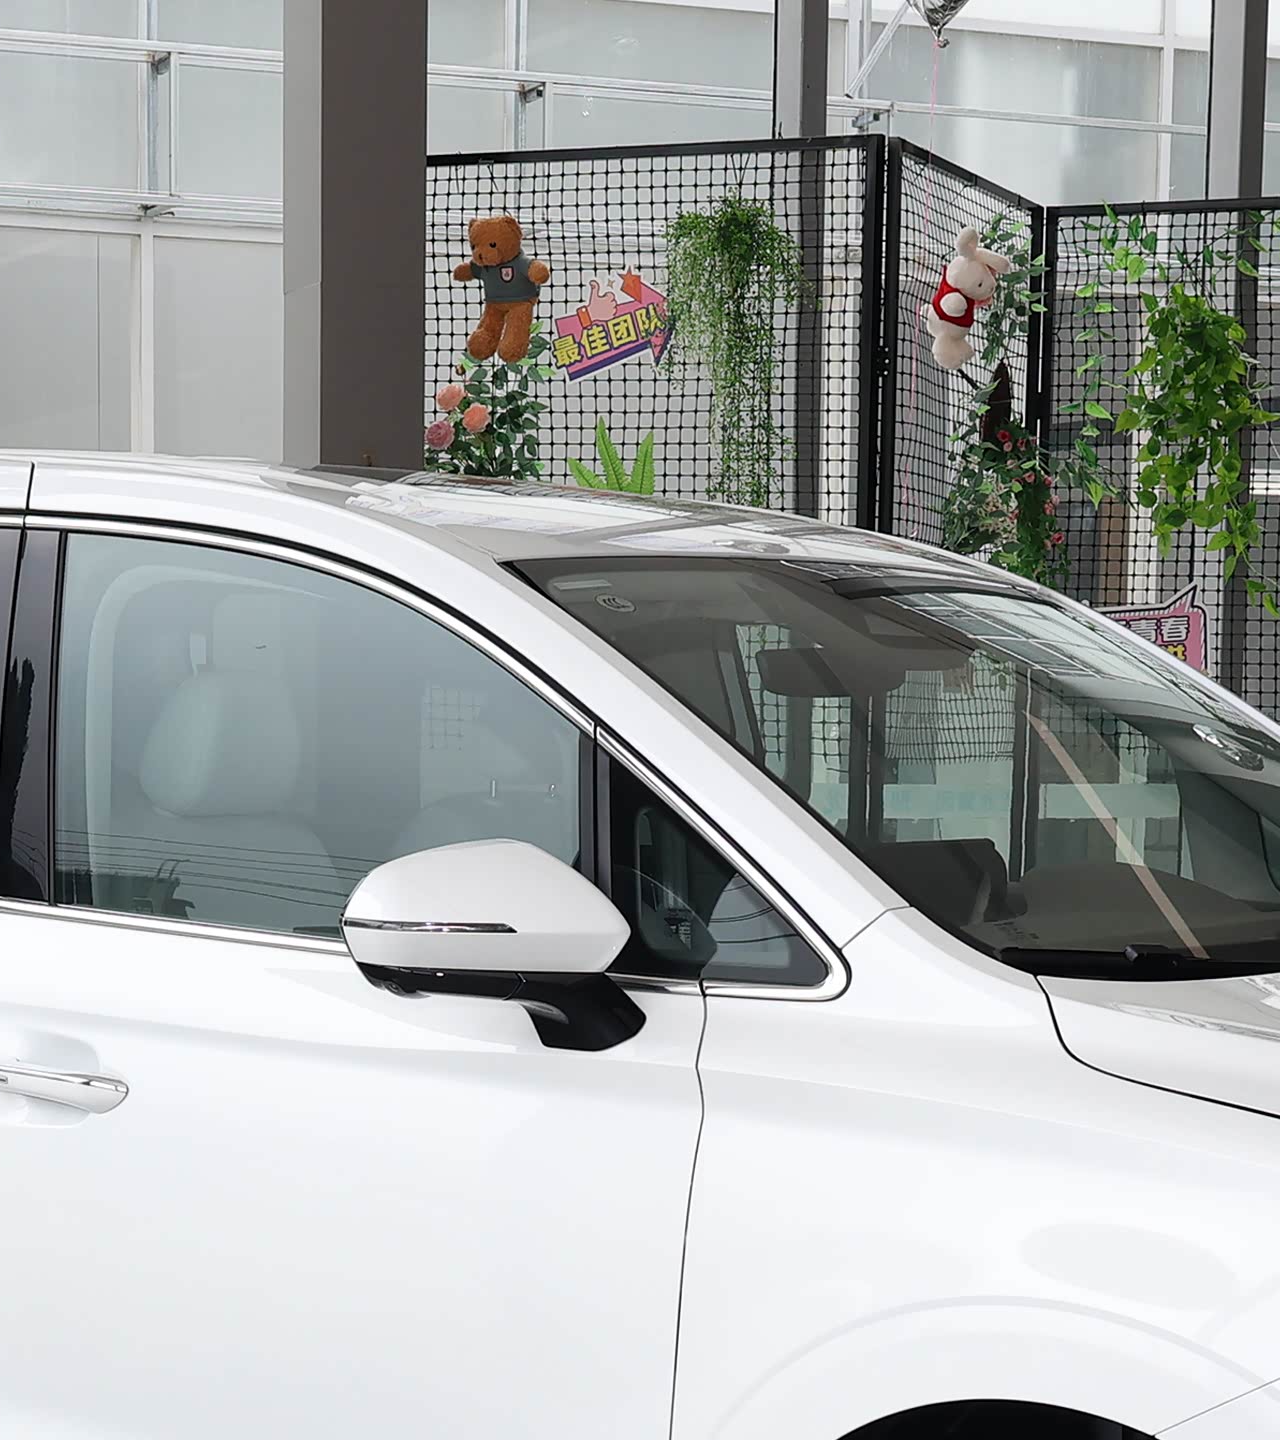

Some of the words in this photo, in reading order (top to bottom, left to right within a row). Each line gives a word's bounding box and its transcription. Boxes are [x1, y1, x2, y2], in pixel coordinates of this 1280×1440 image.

[552, 303, 667, 368] 最佳团队
[1116, 616, 1188, 643] 青春
